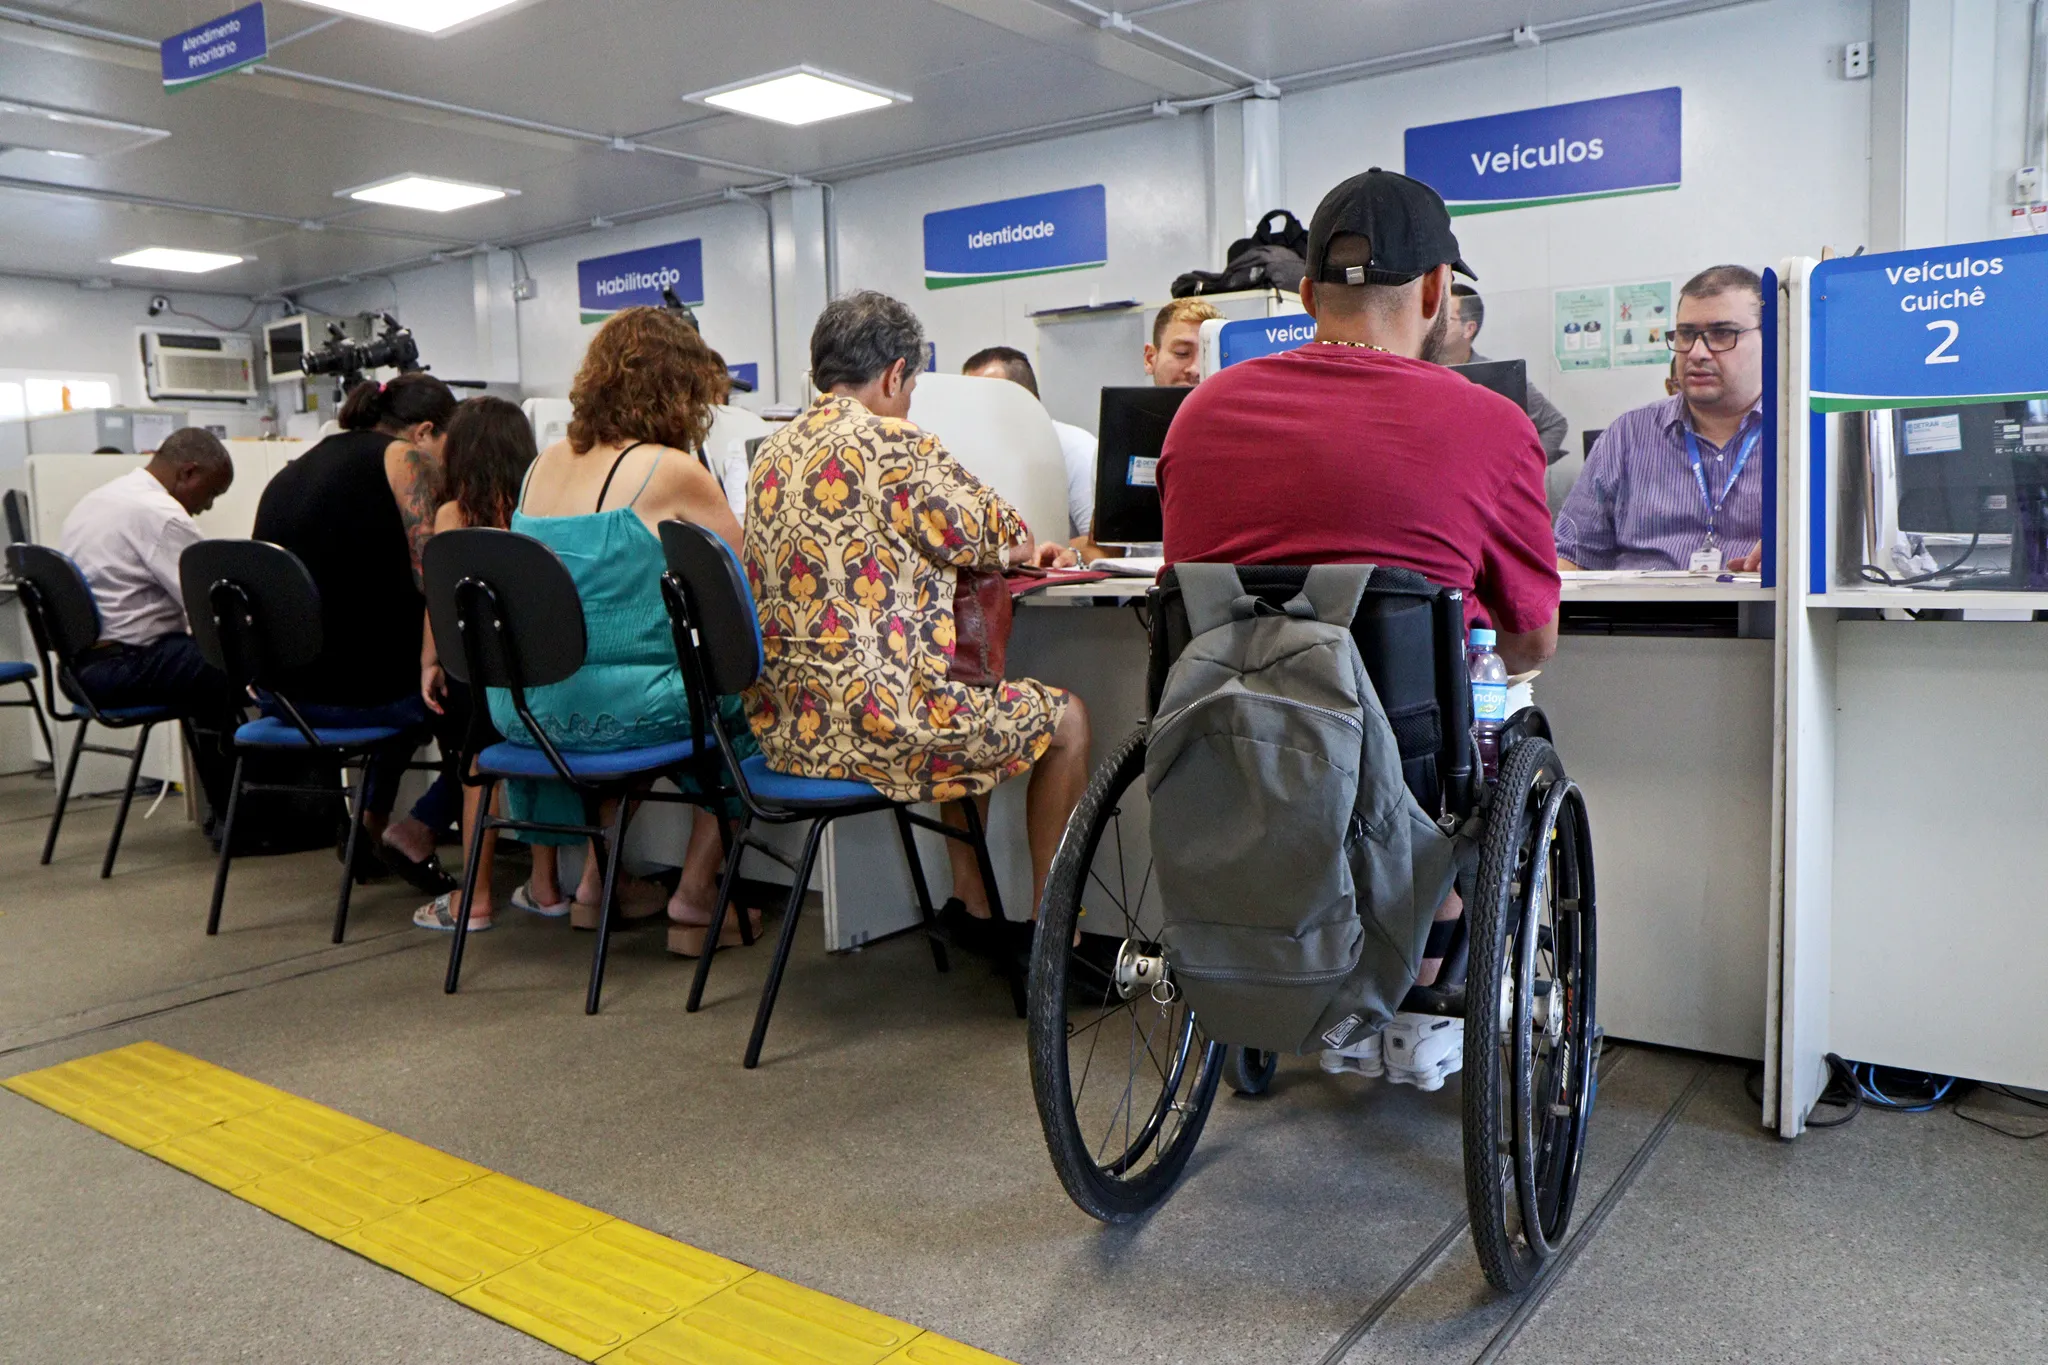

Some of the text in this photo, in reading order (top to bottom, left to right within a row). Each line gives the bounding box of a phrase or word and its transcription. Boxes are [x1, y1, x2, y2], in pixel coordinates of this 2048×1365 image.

[182, 19, 242, 52] Atendimento
[188, 40, 237, 69] Prioritário
[1471, 137, 1604, 176] Veículos
[968, 219, 1056, 250] Identidade
[596, 266, 681, 297] Habilitação
[1884, 256, 2005, 286] Veículos
[1900, 285, 1987, 313] Guichê
[1924, 318, 1961, 365] 2
